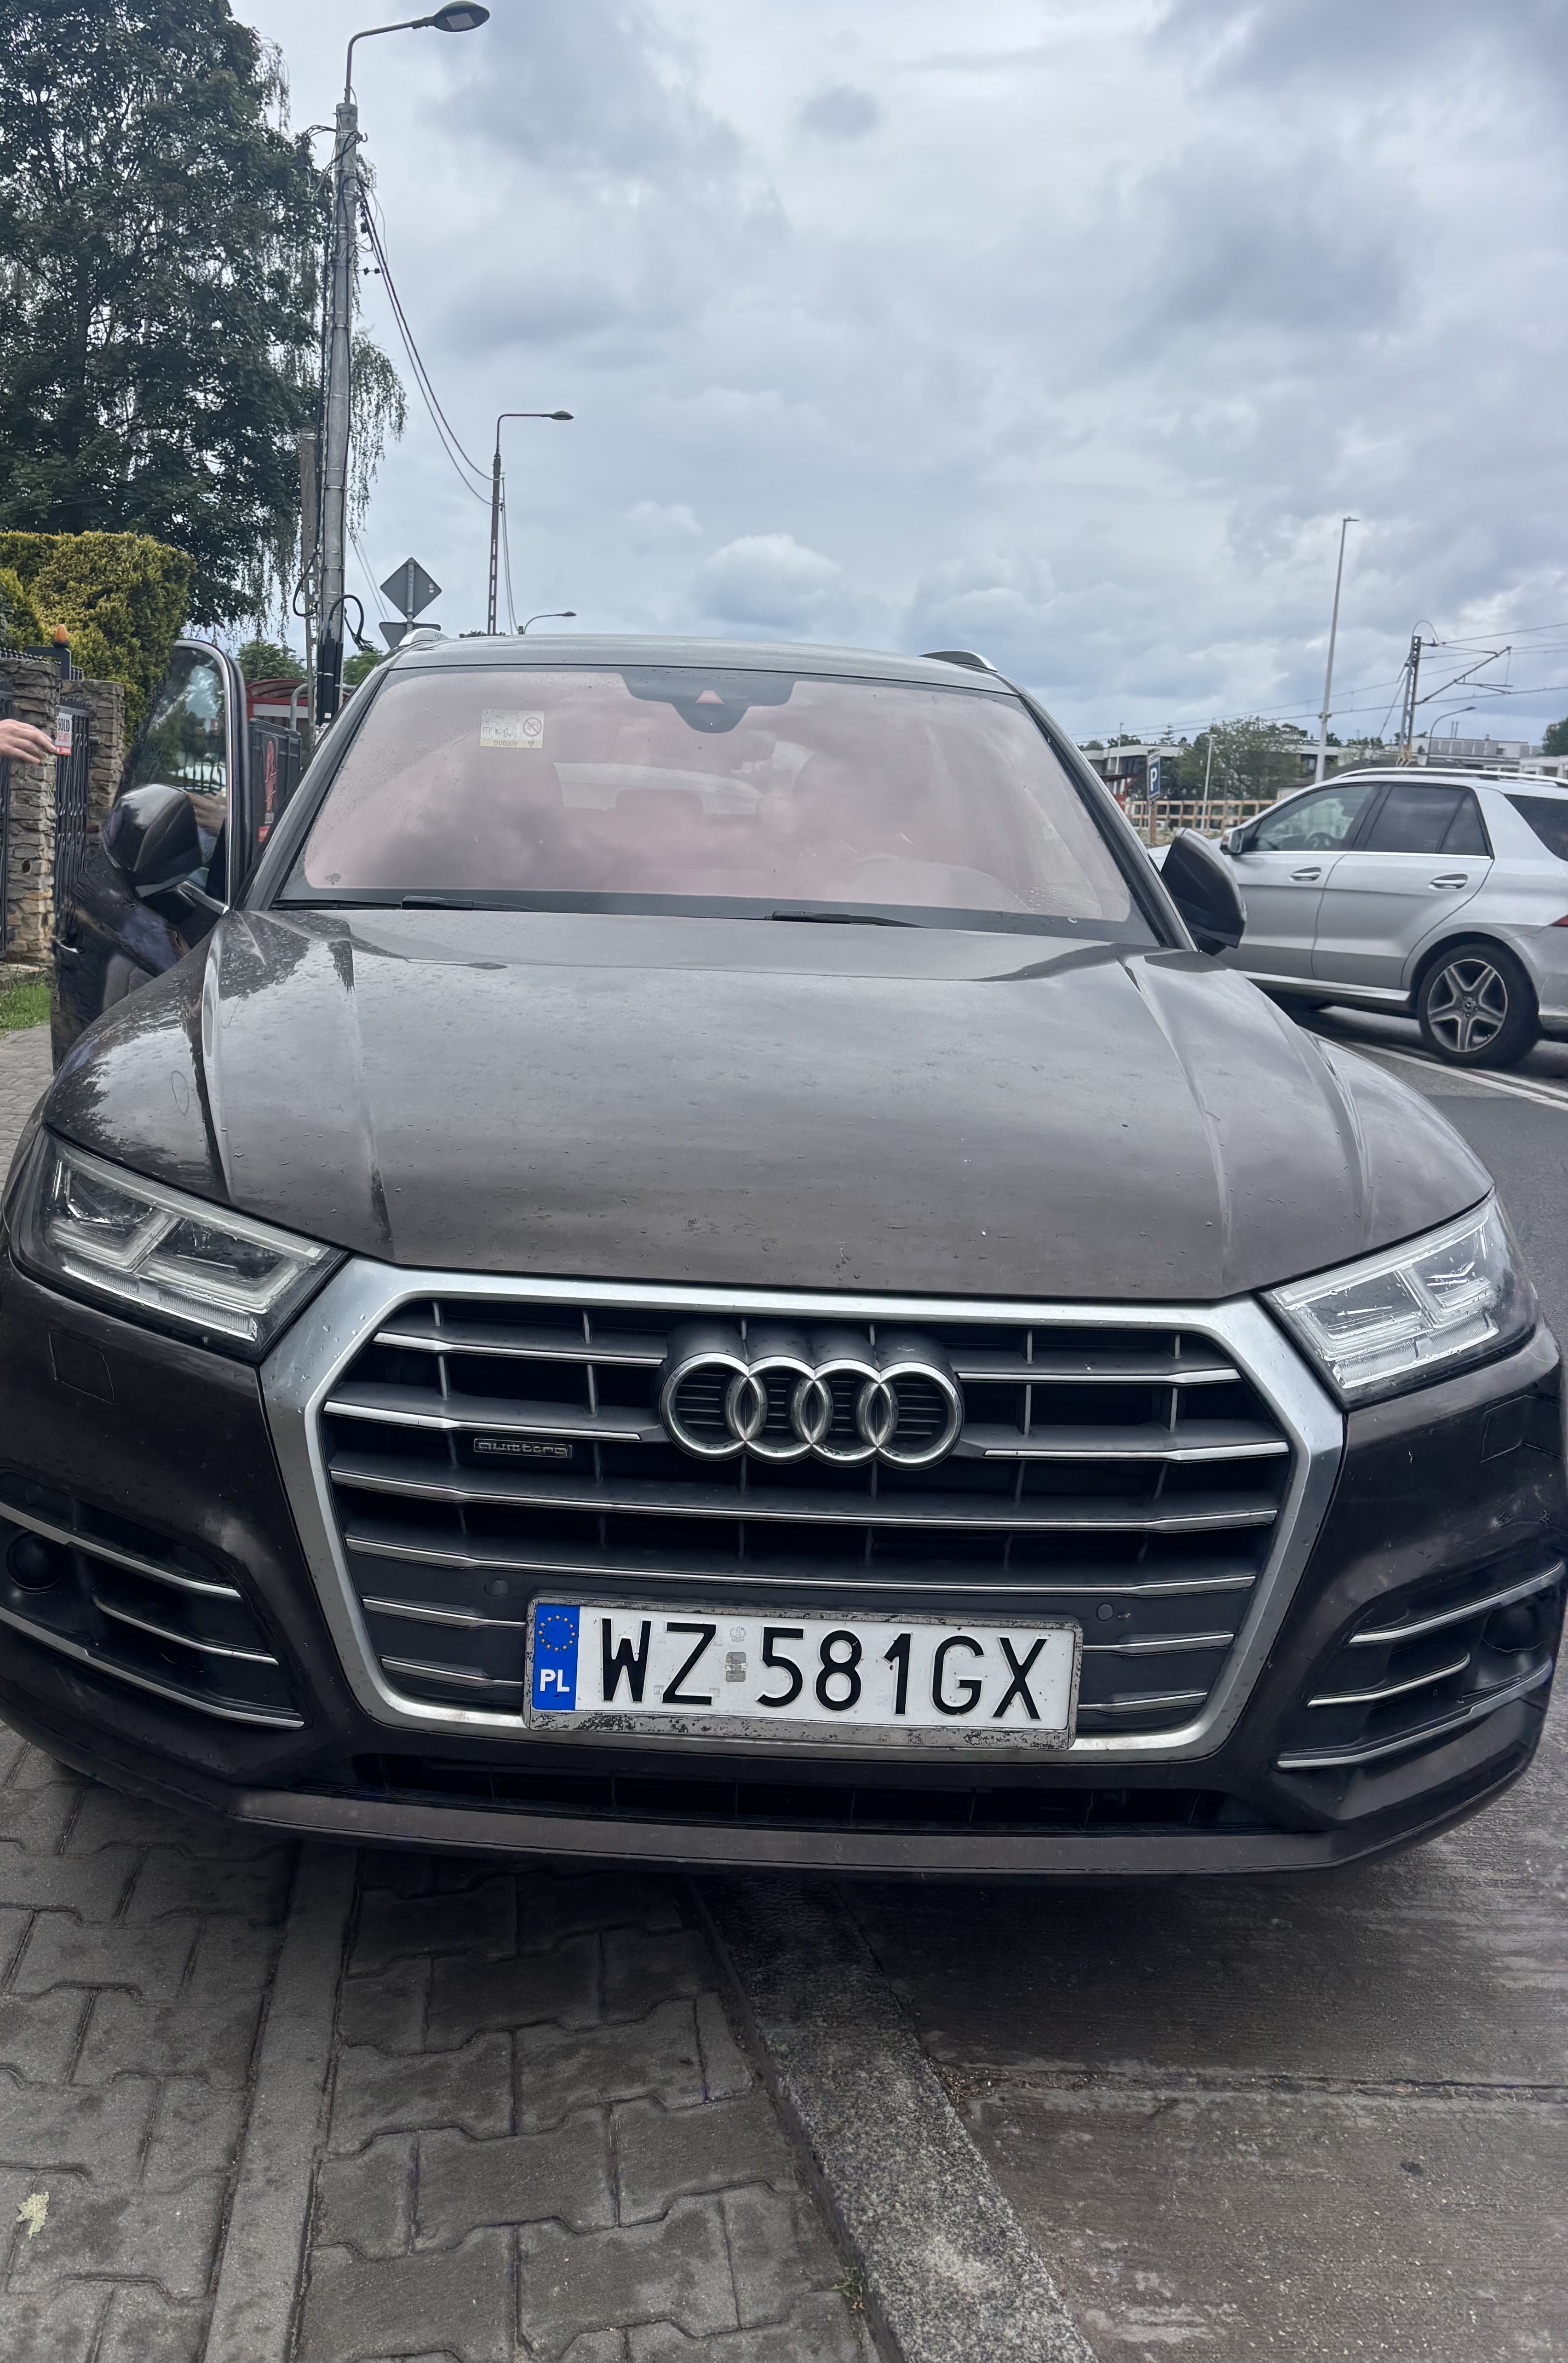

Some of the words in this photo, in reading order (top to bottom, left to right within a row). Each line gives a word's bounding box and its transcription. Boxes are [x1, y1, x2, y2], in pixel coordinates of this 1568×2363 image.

[58, 718, 70, 732] SOLID
[1150, 767, 1158, 791] P
[540, 1669, 570, 1692] PL
[602, 1618, 717, 1706] WZ
[757, 1626, 1048, 1720] 581GX
